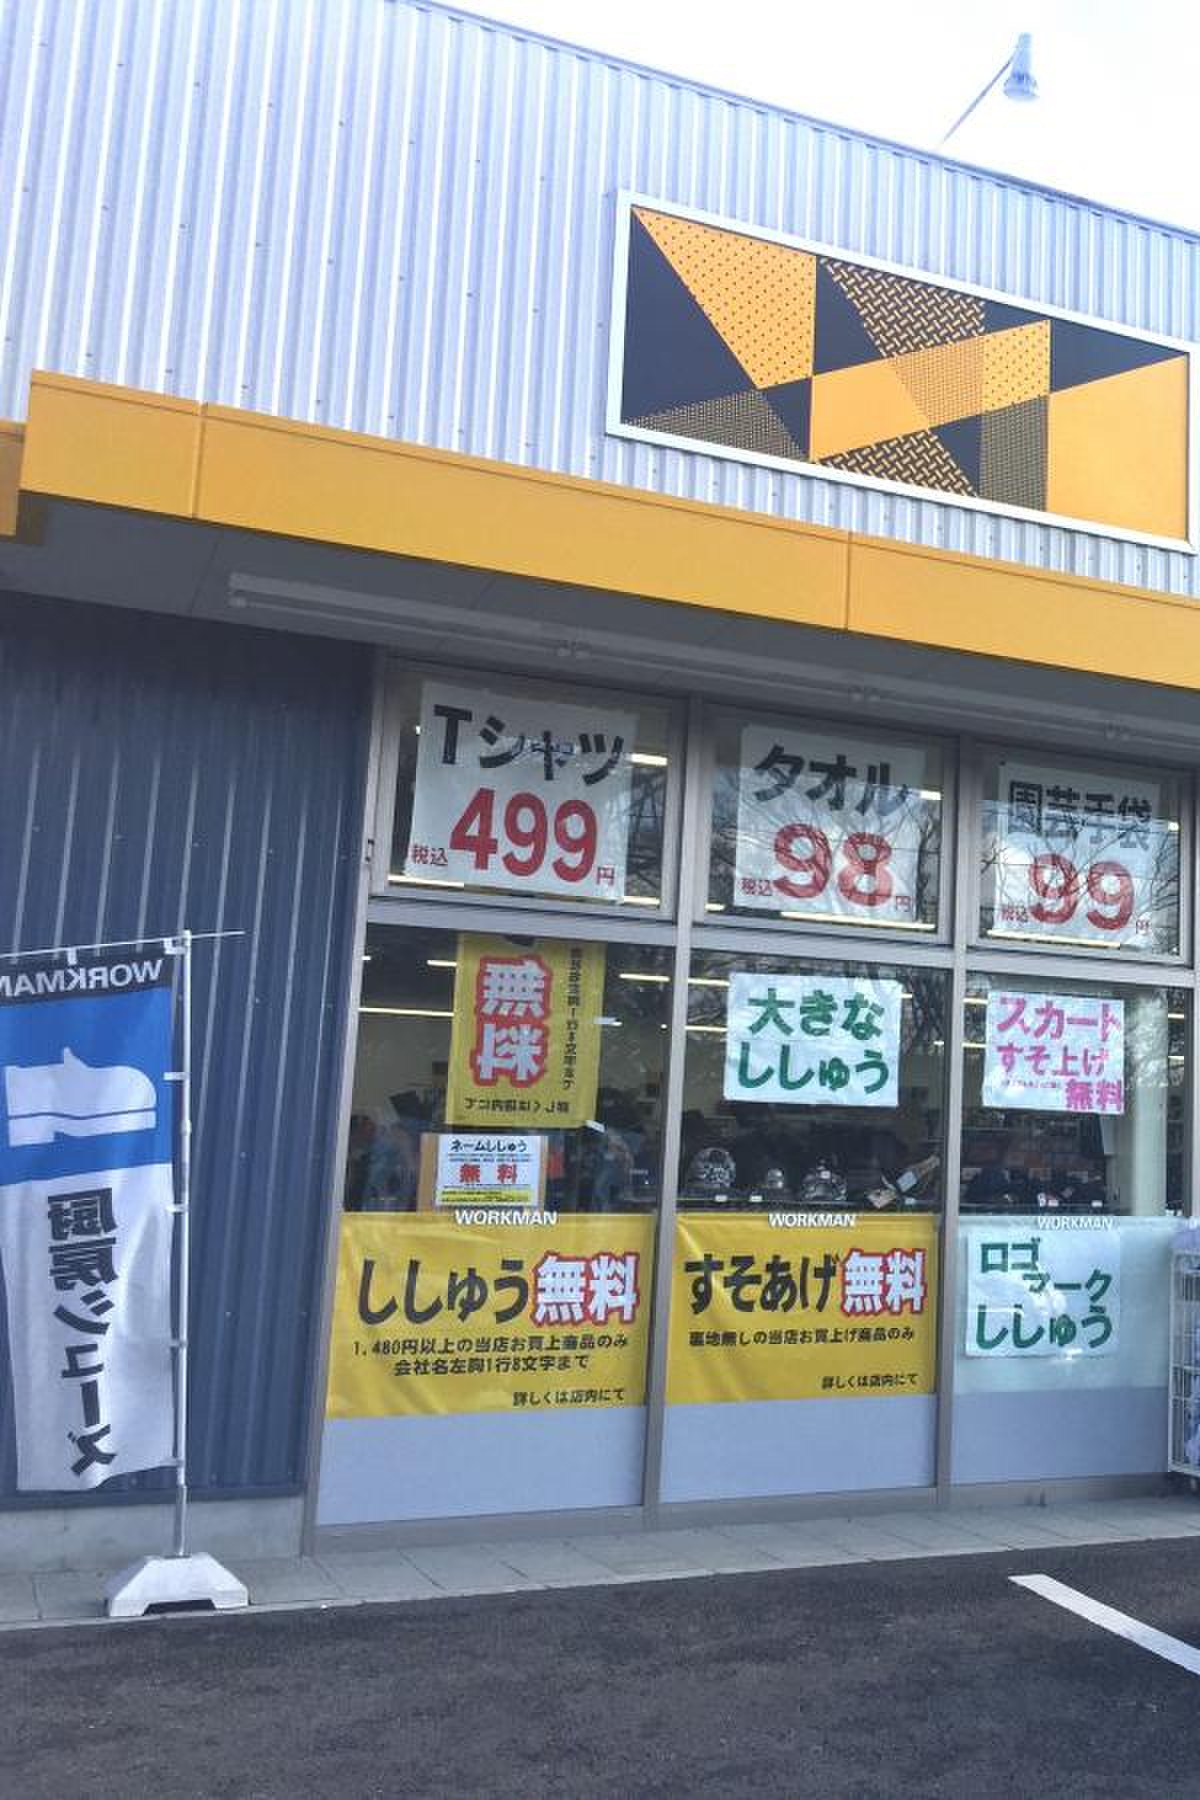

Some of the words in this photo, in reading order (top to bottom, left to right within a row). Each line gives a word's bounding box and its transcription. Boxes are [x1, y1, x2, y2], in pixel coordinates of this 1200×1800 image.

[433, 704, 625, 785] Tシャツ
[753, 745, 910, 815] タオル
[411, 846, 448, 867] 税込
[449, 788, 598, 883] 499
[597, 866, 616, 887] 円
[1008, 781, 1152, 850] 園芸手袋
[773, 823, 894, 906] 98
[1029, 853, 1134, 930] 99
[747, 988, 884, 1041] 大きな
[996, 996, 1121, 1041] スカート
[737, 1042, 890, 1093] ししゅう
[996, 1041, 1110, 1078] すそ上げ
[1065, 1079, 1122, 1112] 無料
[451, 1138, 528, 1153] ネームししゅう
[455, 1209, 558, 1226] WORKMAN
[769, 1213, 856, 1228] WORKMAN
[980, 1236, 1041, 1273] ロゴ
[976, 1303, 1112, 1350] ししゅう
[512, 1387, 625, 1407] 詳しくは店内にて
